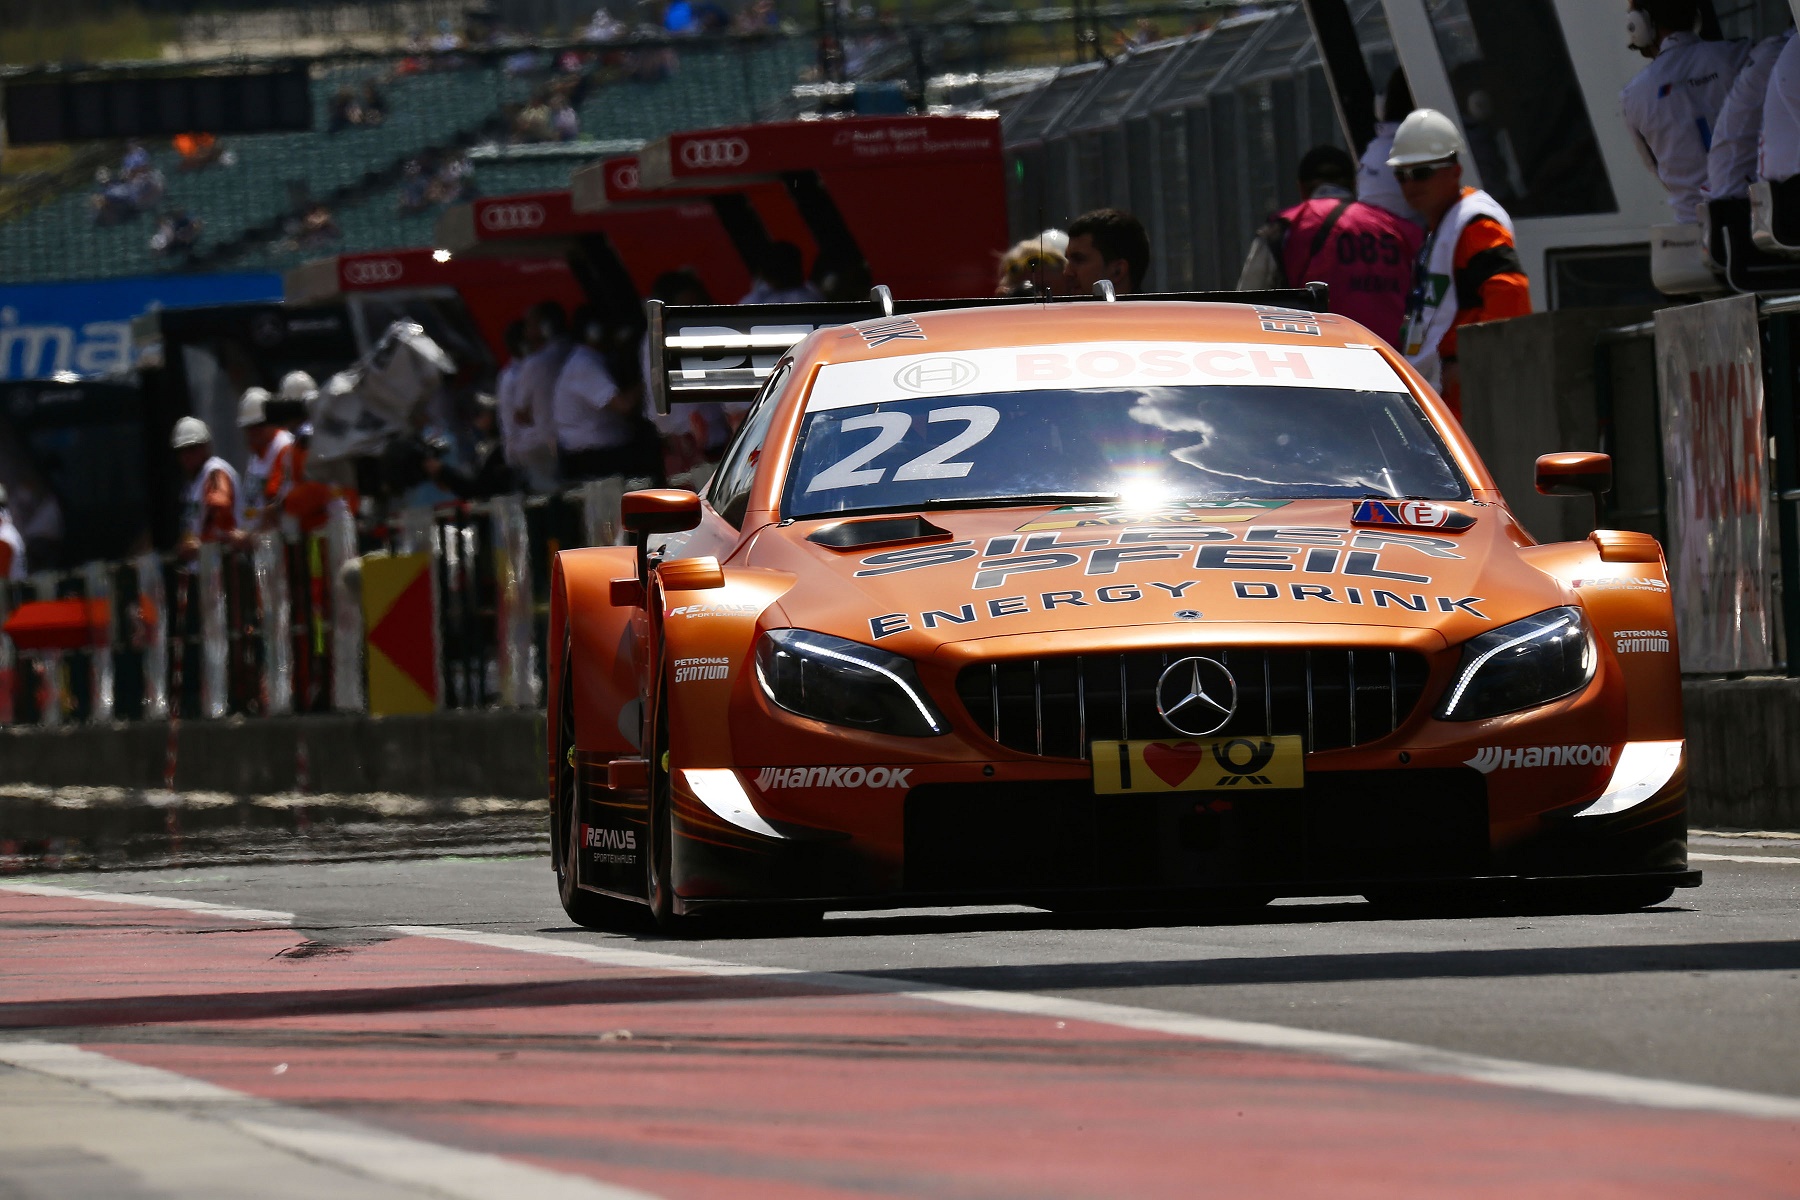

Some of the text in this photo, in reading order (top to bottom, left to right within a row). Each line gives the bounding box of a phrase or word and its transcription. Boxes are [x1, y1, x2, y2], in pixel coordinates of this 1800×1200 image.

[1336, 232, 1401, 265] 085
[1015, 349, 1315, 382] BOSCH
[805, 405, 1001, 494] 22
[971, 544, 1432, 590] PFEIL
[669, 604, 758, 617] REMUS
[868, 580, 1492, 640] ENERGY DRINK
[1613, 630, 1668, 638] PETRONAS
[1617, 638, 1669, 653] SYNTIUM
[674, 657, 729, 667] PETRONAS
[675, 665, 729, 683] SYNTIUM
[586, 827, 636, 850] REMUS
